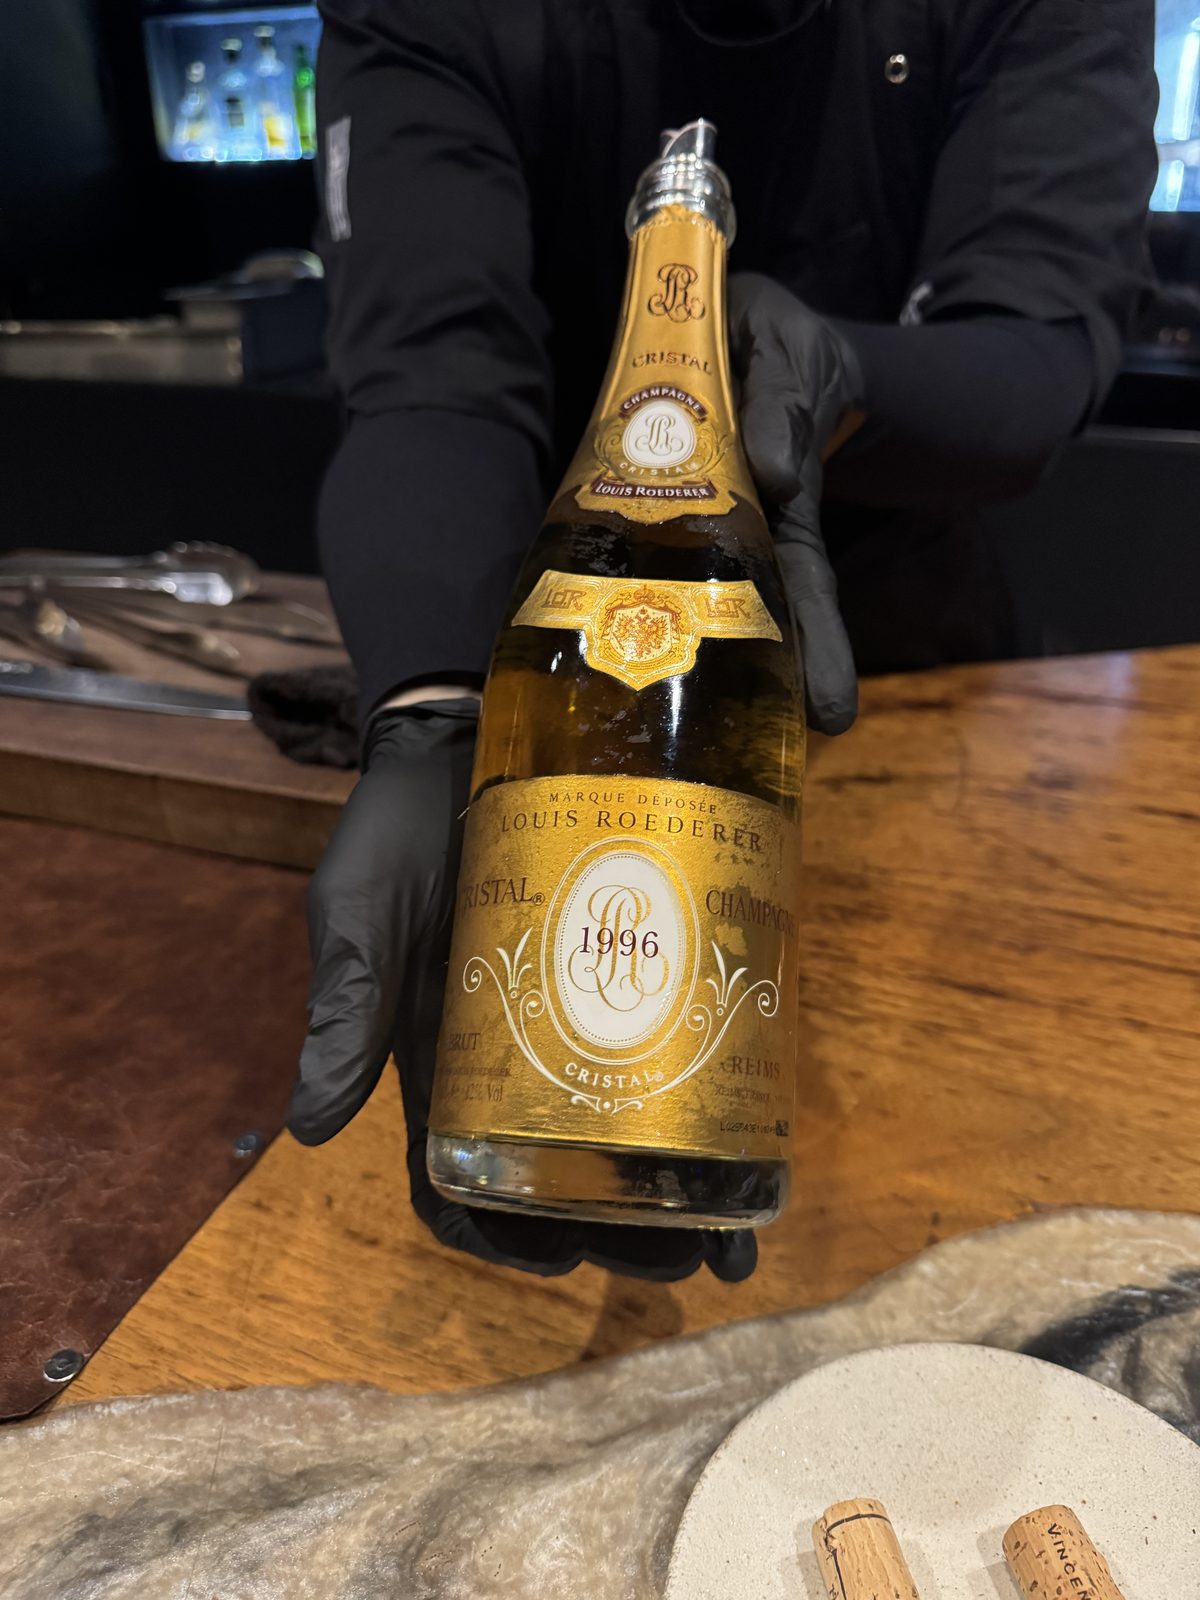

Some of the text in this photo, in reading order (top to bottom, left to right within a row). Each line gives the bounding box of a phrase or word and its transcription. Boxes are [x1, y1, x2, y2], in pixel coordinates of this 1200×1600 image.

[632, 351, 712, 375] CRISTAL
[623, 385, 702, 412] CHAMPAGNE
[597, 482, 709, 497] LOUIS ROEDERER
[549, 791, 625, 804] MARQUE
[502, 809, 763, 854] LOUIS ROEDERER
[579, 926, 660, 960] 1996
